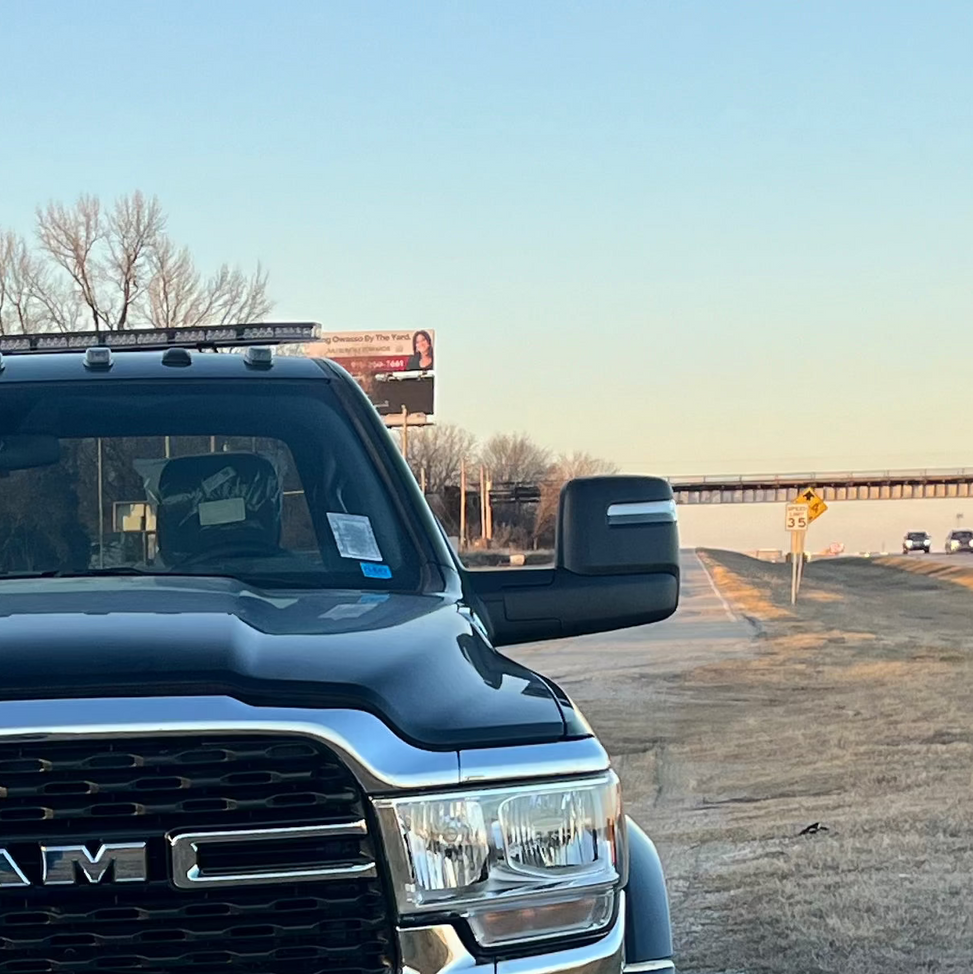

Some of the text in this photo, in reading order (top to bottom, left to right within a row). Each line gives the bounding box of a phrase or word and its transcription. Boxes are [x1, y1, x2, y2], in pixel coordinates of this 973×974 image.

[332, 335, 364, 343] Owasso
[364, 334, 375, 343] By
[375, 333, 391, 341] The
[787, 517, 807, 528] 35
